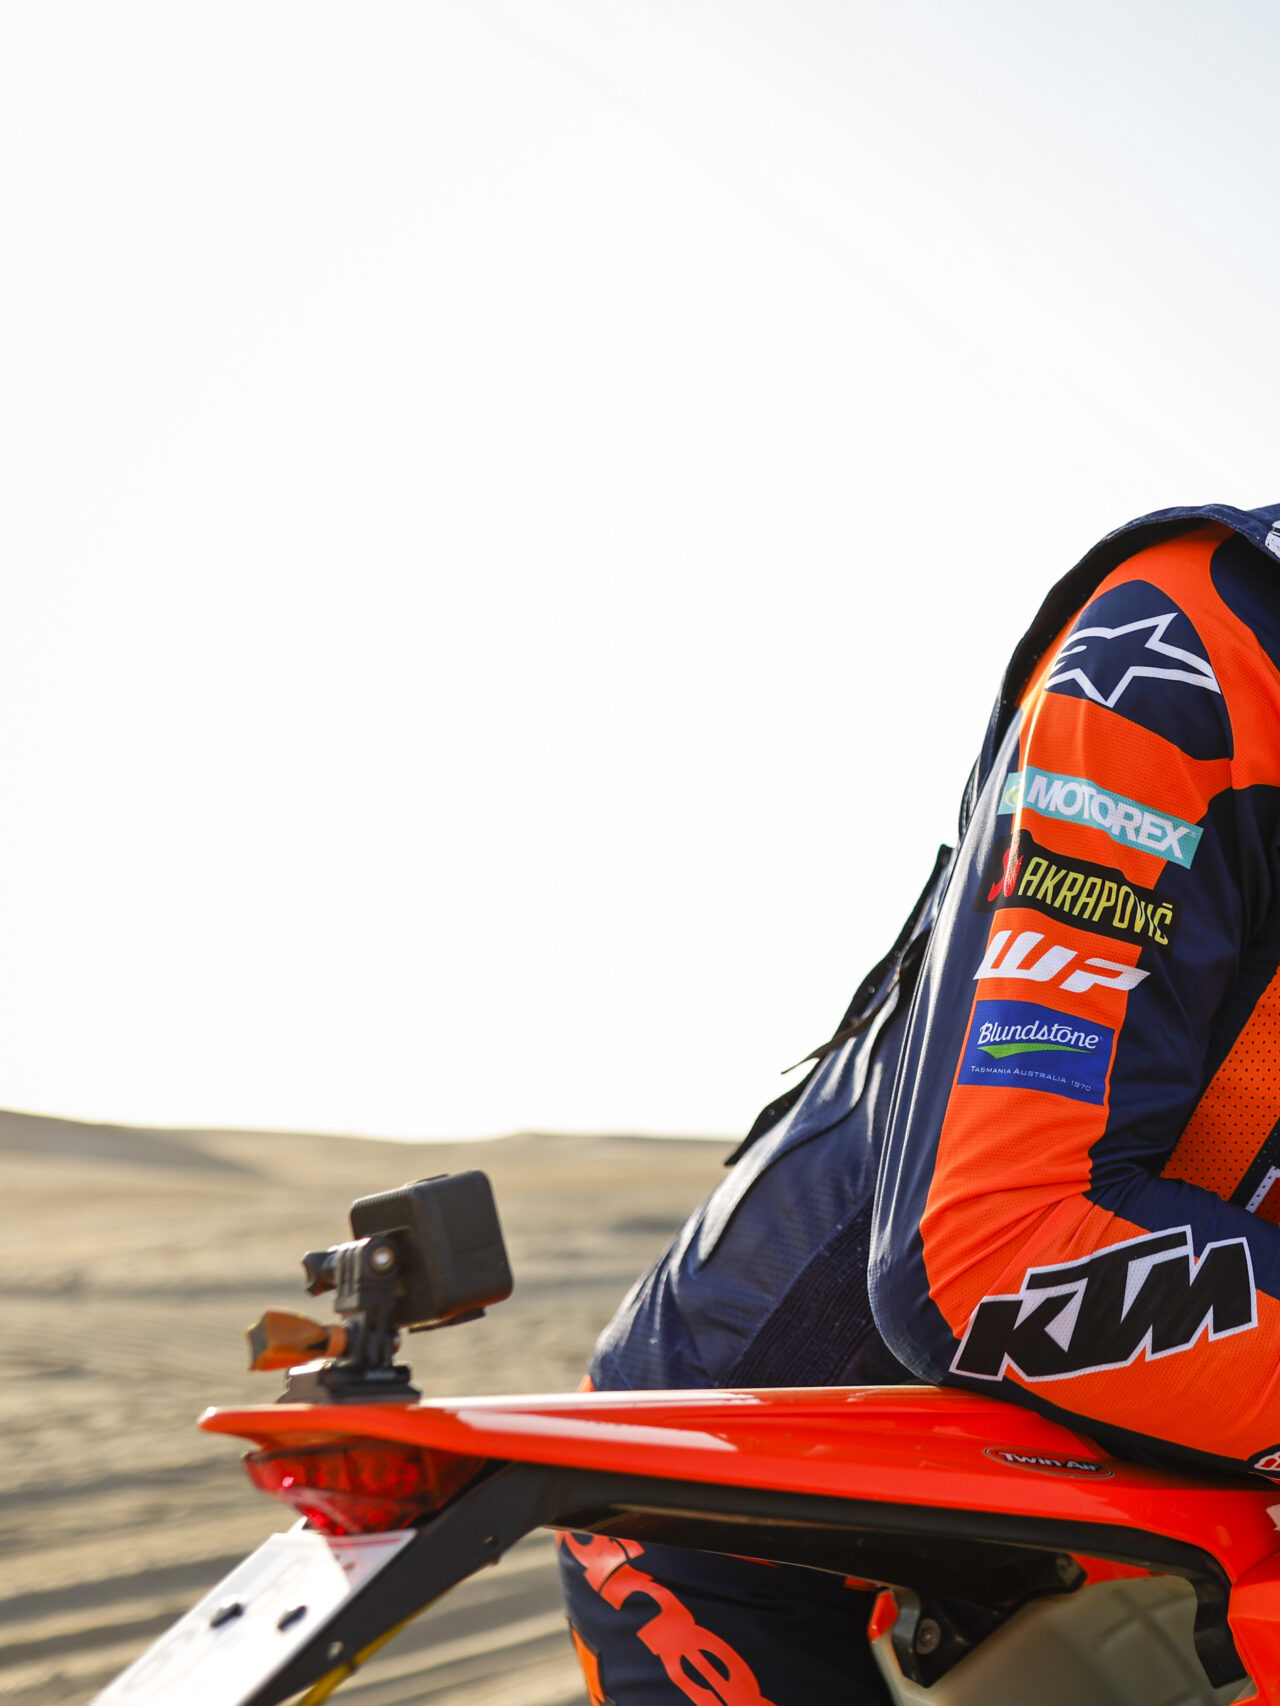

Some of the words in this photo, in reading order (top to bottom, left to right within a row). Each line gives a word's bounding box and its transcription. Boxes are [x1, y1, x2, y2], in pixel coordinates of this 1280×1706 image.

[1027, 775, 1190, 859] MOTOREX
[973, 930, 1151, 993] WP
[977, 1020, 1100, 1049] Blundstone
[949, 1225, 1259, 1382] KTM
